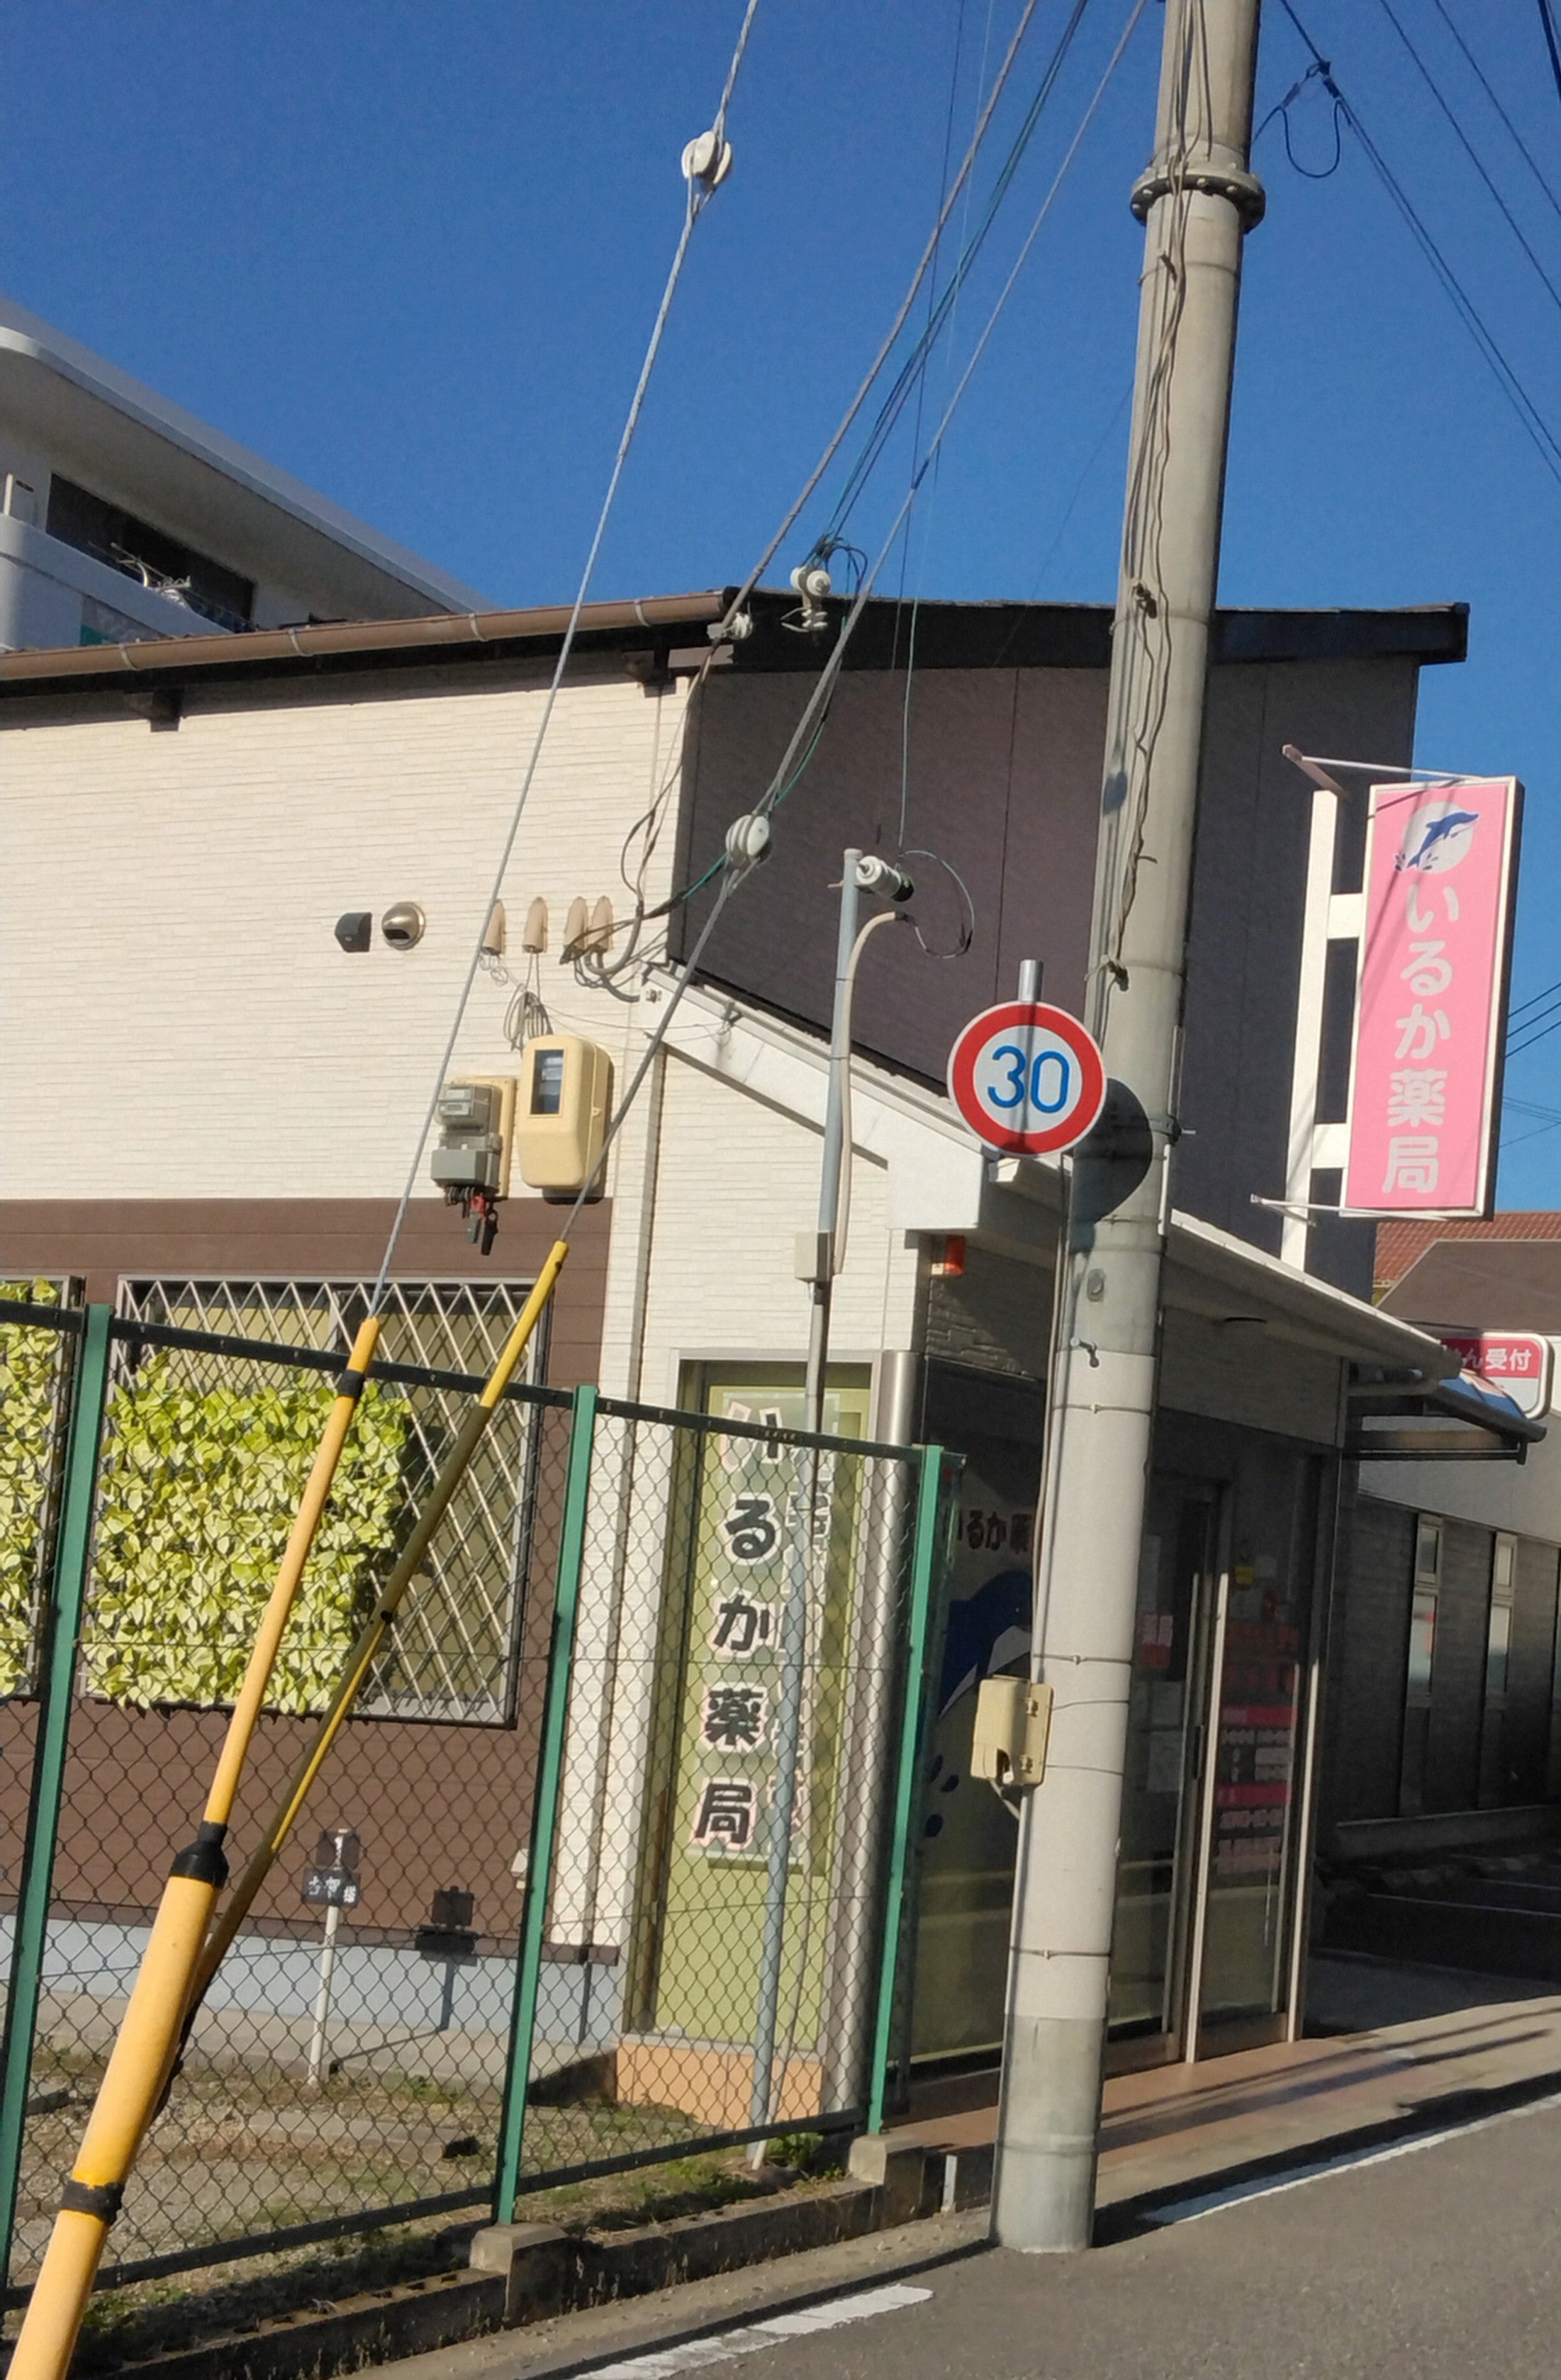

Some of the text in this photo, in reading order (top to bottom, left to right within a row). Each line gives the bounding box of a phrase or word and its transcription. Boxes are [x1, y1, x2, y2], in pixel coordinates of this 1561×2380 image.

[1382, 884, 1458, 1194] いるか薬局
[987, 1044, 1070, 1114] 30
[1454, 1348, 1532, 1371] ん受付
